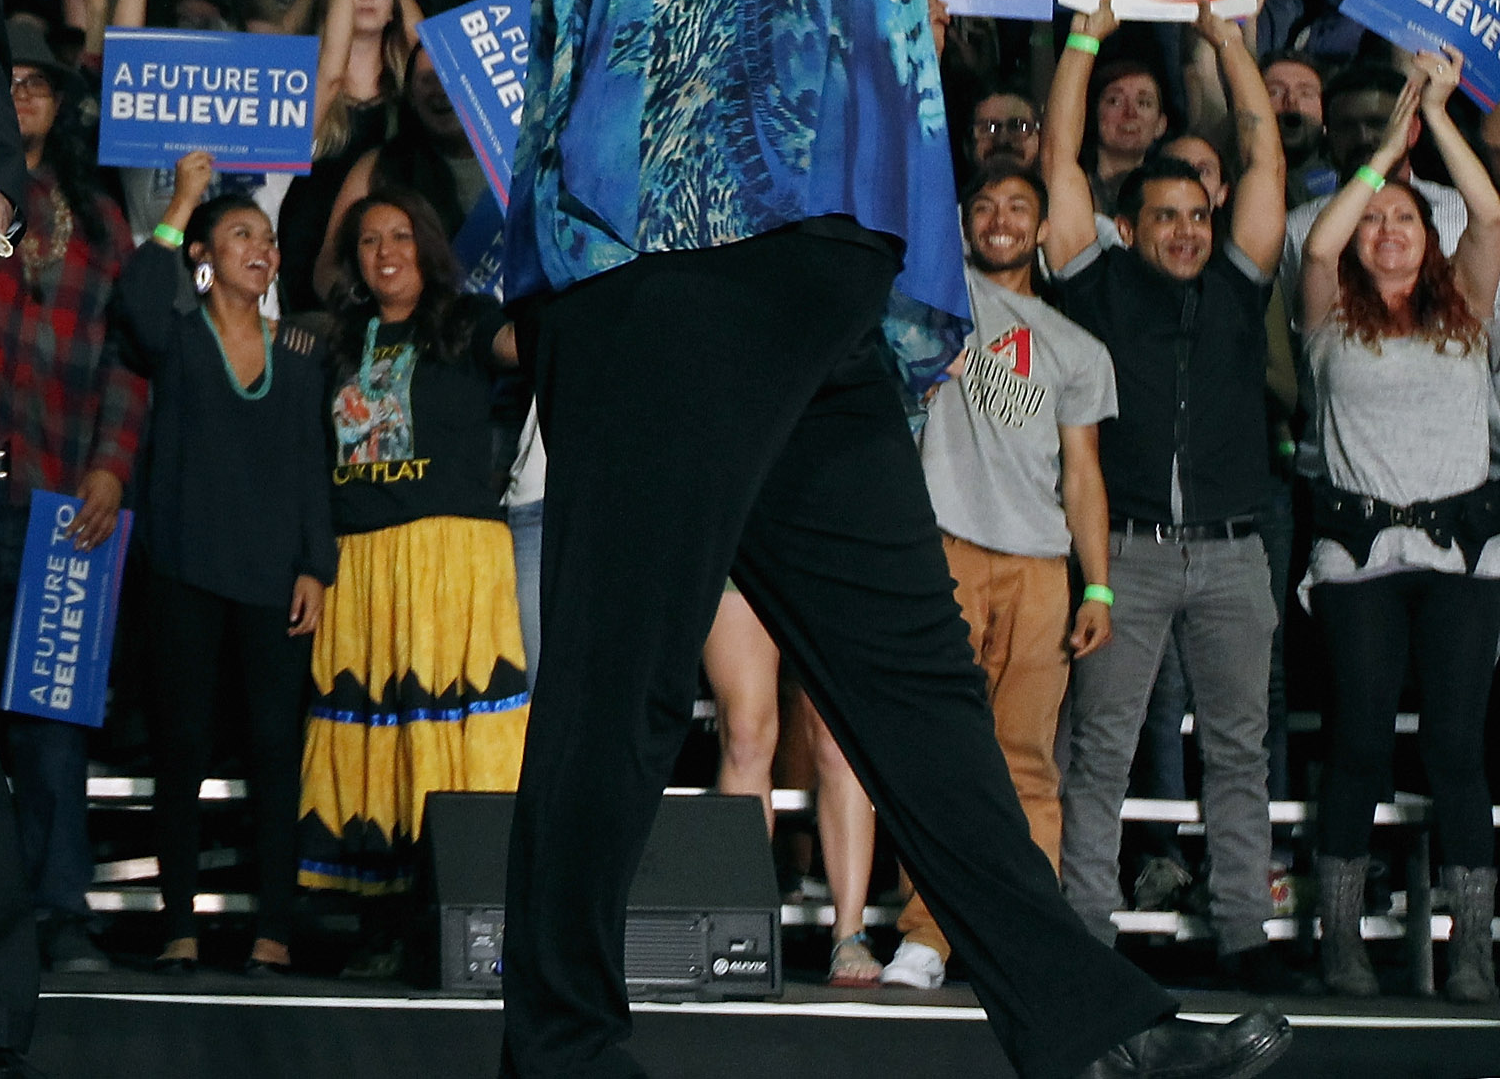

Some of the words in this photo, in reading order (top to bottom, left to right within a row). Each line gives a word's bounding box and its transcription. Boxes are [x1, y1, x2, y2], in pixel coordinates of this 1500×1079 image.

[488, 4, 512, 27] A
[114, 62, 134, 86] A
[141, 63, 260, 93] FUTURE
[267, 68, 308, 96] TO
[459, 9, 525, 127] BELIE
[111, 91, 260, 127] BELIEVE
[268, 98, 308, 129] IN
[370, 458, 431, 483] FLAT
[50, 504, 76, 547] TO
[32, 554, 67, 676] FUTURE
[49, 557, 90, 711] BELIEVE
[29, 684, 49, 705] A
